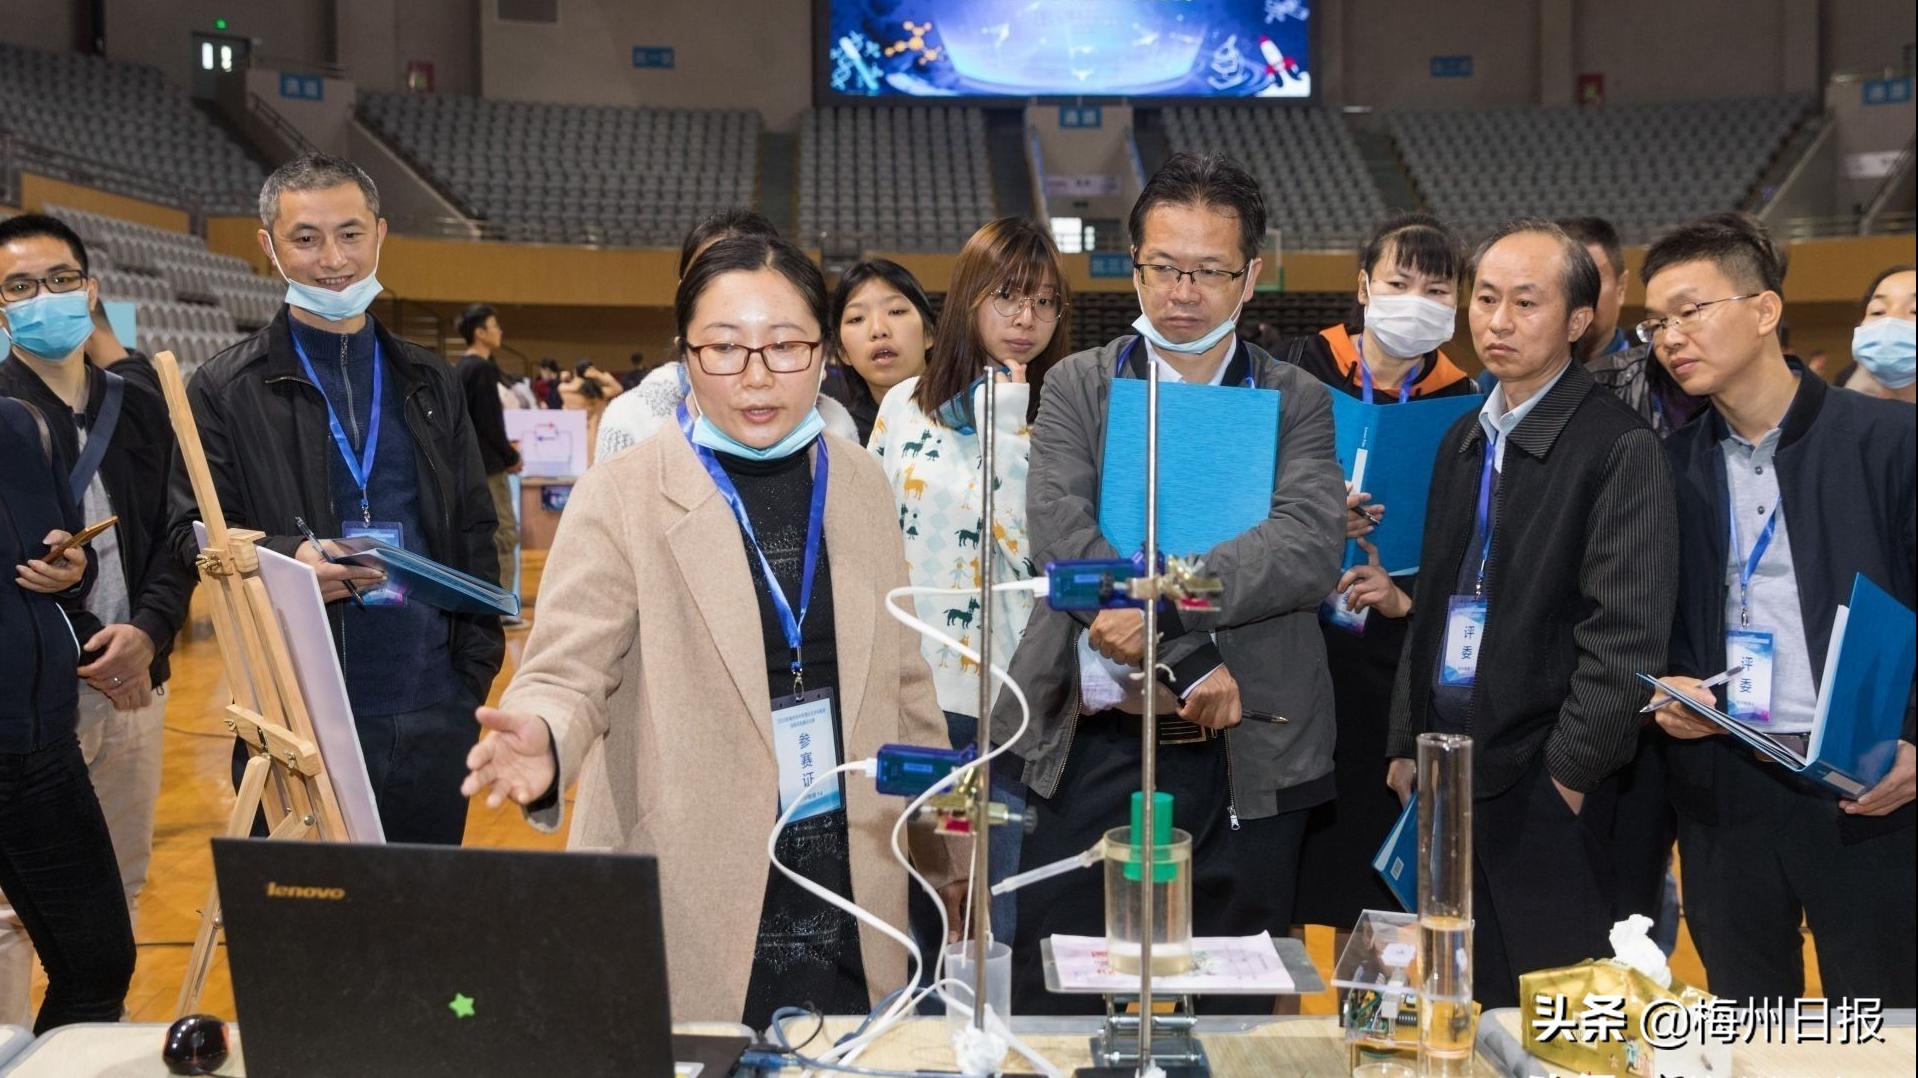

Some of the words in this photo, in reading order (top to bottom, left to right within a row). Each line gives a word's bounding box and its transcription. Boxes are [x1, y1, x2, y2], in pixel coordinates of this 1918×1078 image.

[1460, 625, 1476, 660] 评委
[798, 732, 815, 787] 参赛证
[266, 881, 346, 899] lenovo
